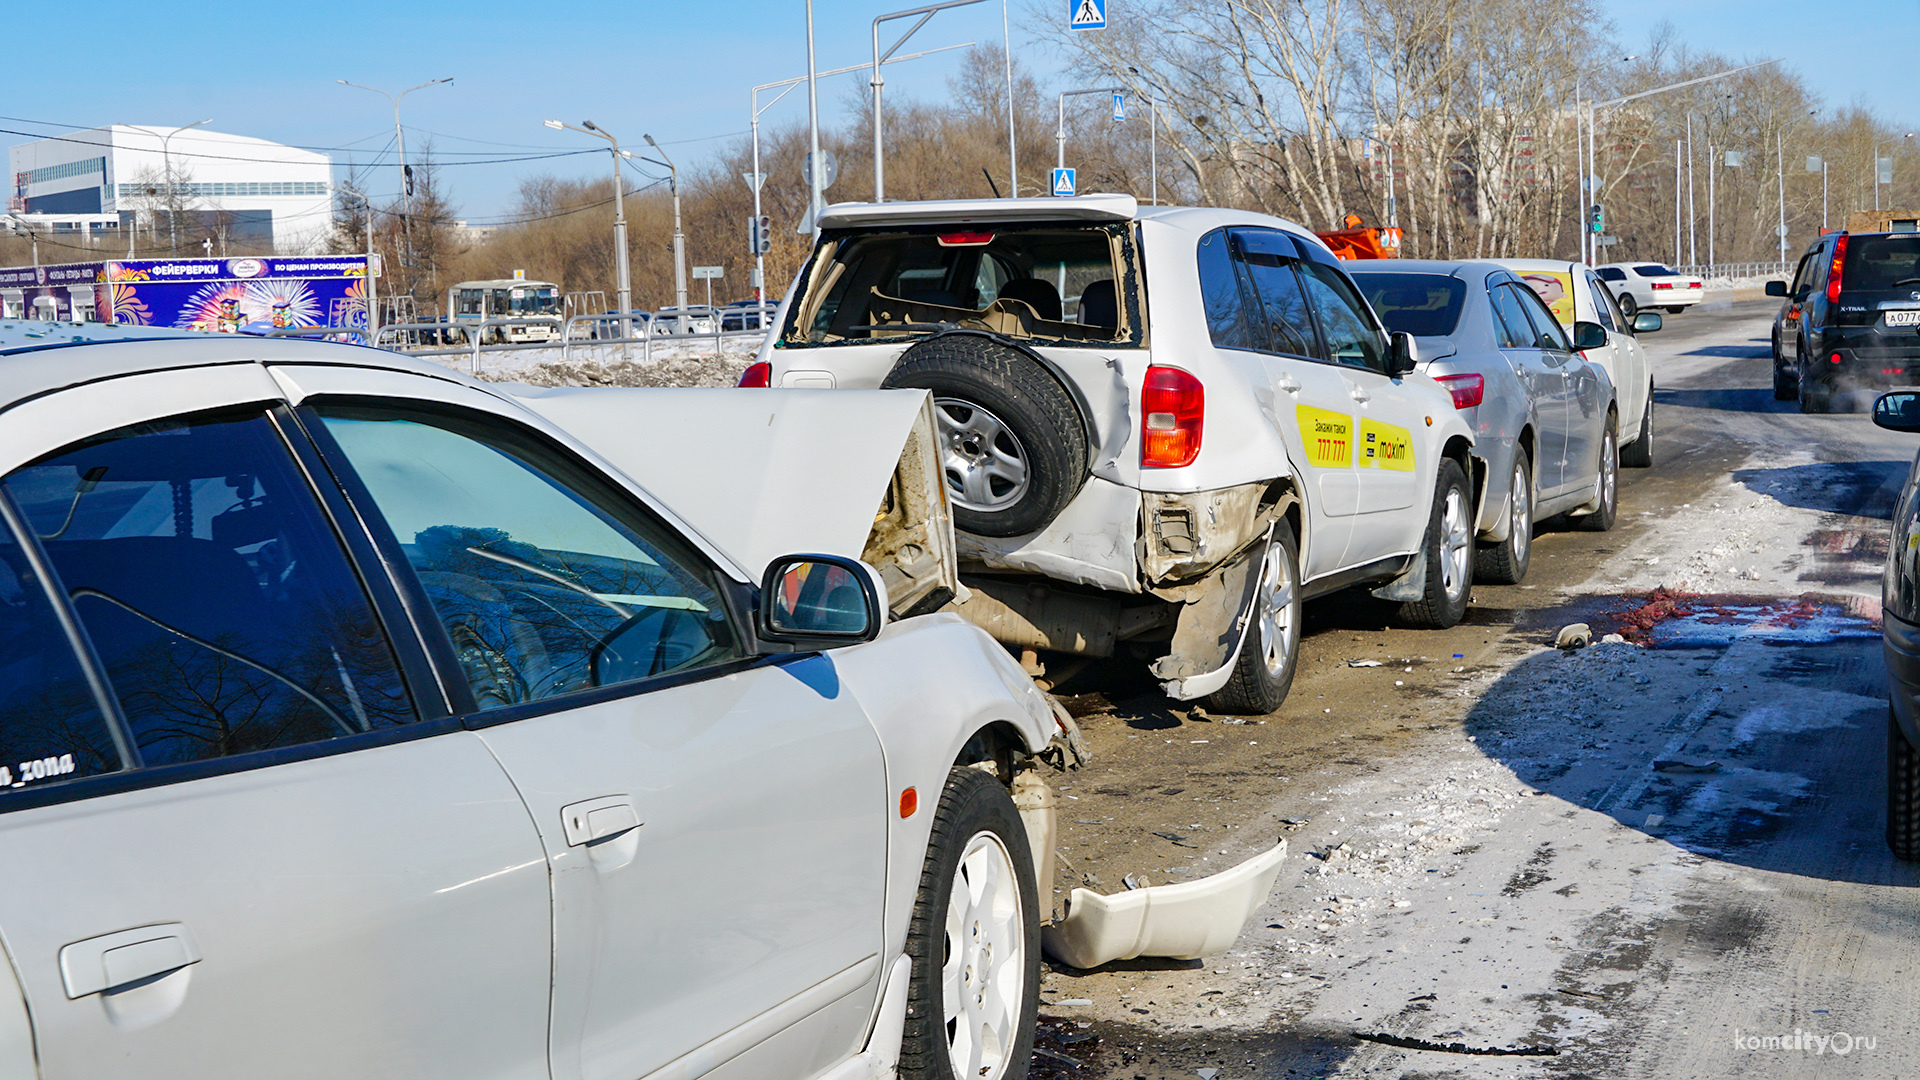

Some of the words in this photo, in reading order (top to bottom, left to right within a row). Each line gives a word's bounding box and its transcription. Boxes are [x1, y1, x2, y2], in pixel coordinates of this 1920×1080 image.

[152, 264, 219, 276] ФЕЙЕРВЕРКИ
[274, 264, 286, 272] ПО
[286, 263, 309, 272] ЦЕНАМ
[310, 262, 365, 271] ПРОИЗВОДИТЕЛЯ
[1318, 438, 1331, 460] 777
[1333, 440, 1346, 462] 777
